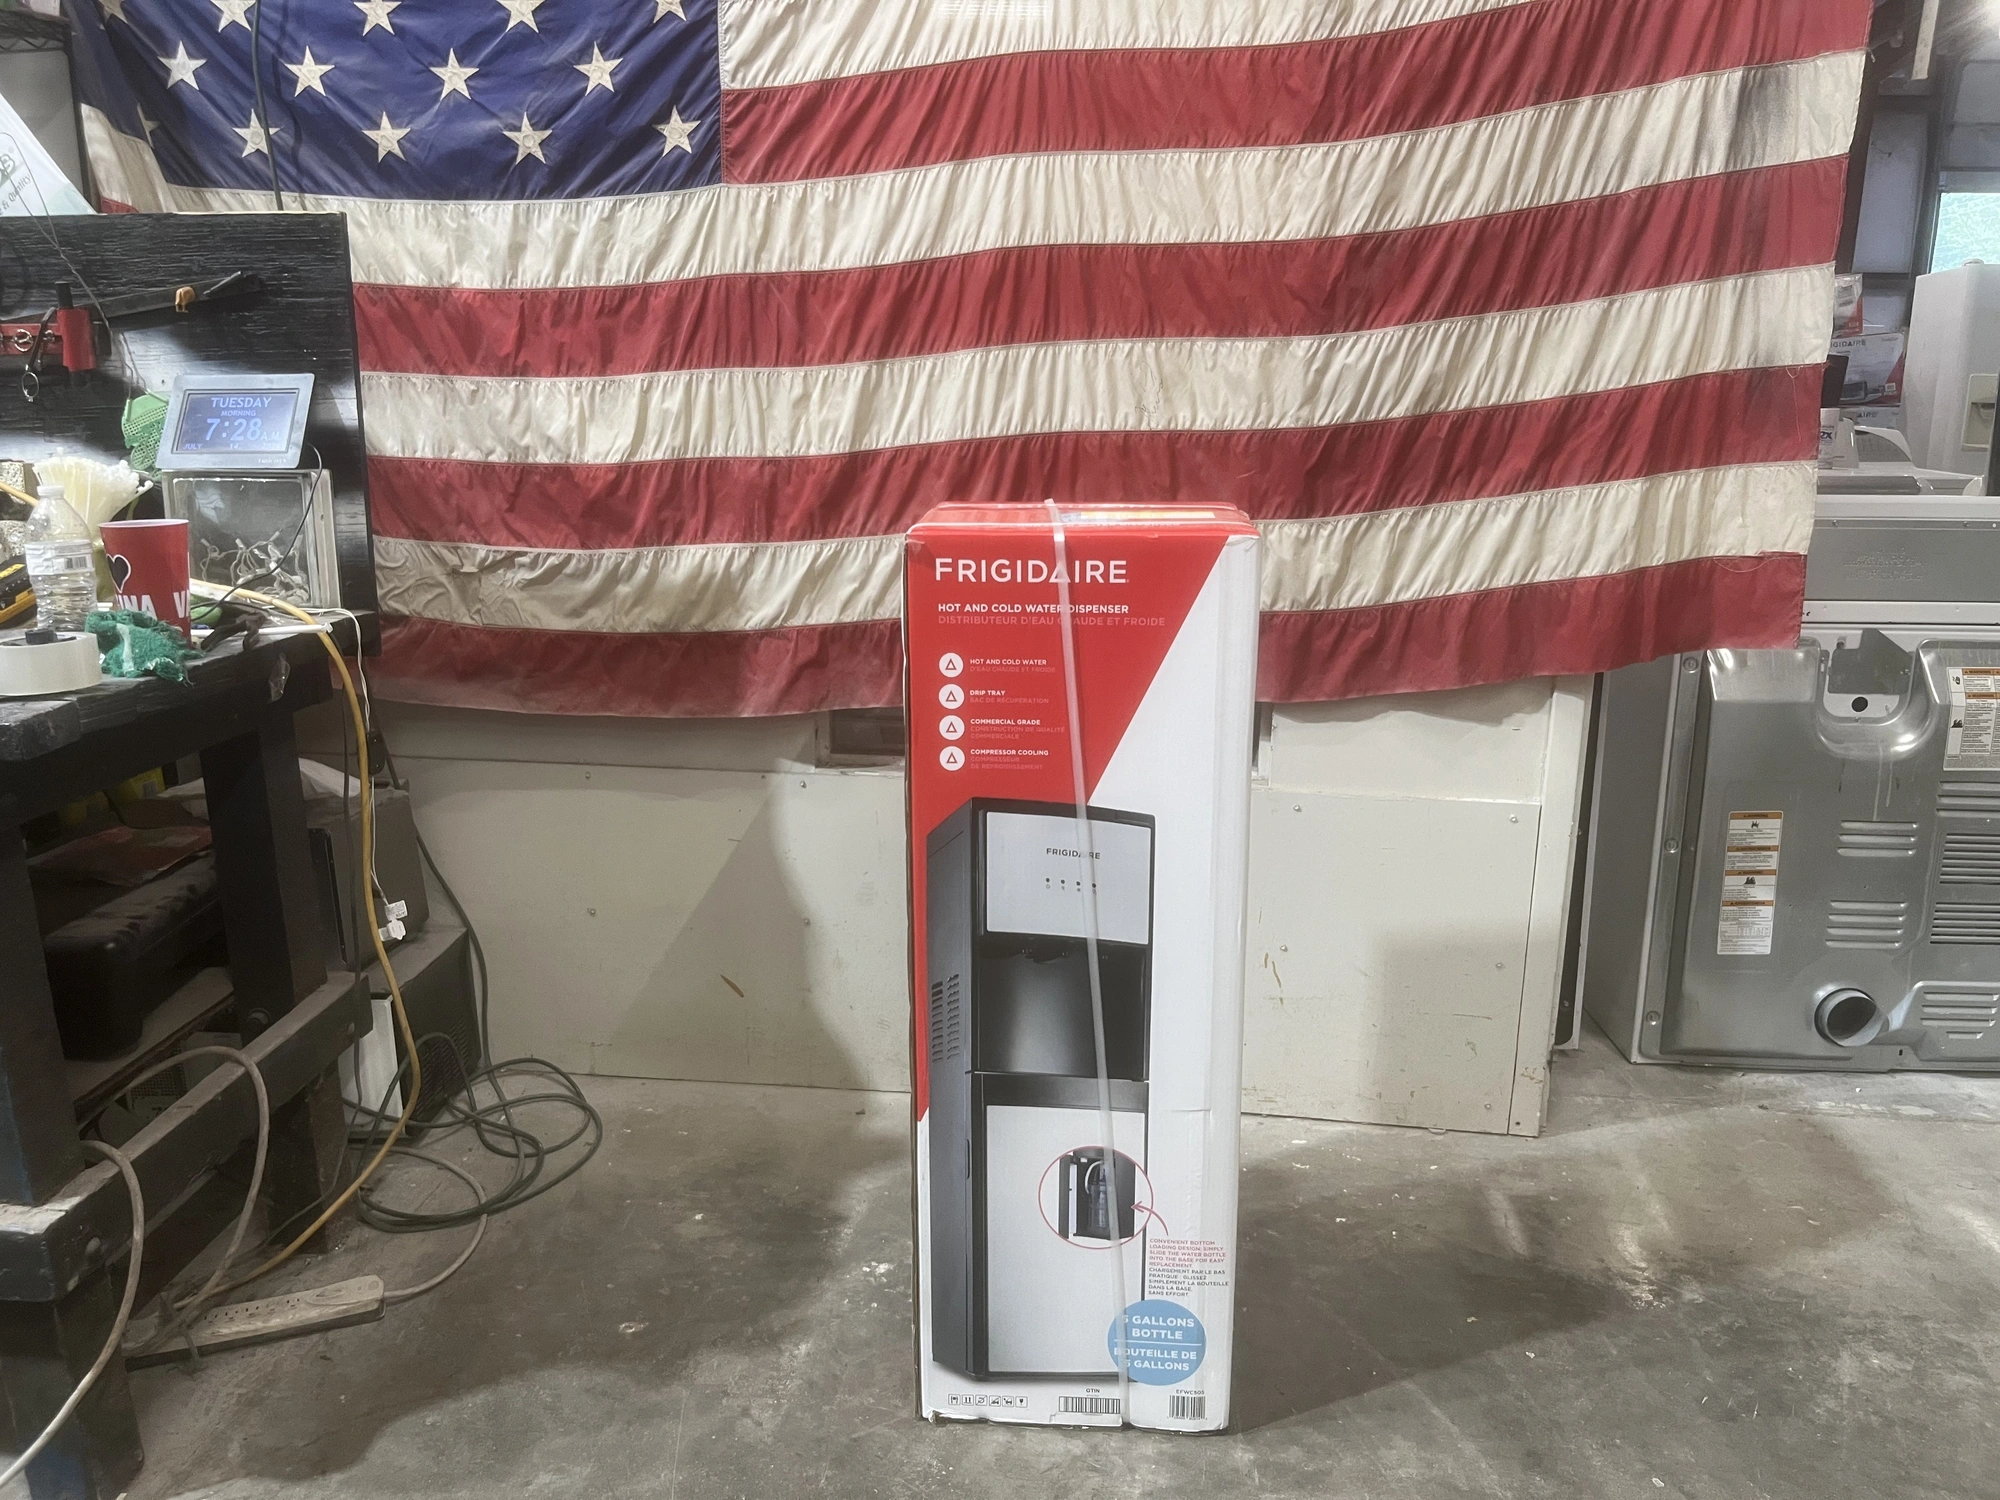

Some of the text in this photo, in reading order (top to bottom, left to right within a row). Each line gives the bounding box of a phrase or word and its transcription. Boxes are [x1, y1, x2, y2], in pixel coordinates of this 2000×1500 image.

[211, 397, 272, 408] TUESDAY
[205, 418, 263, 441] 7:28
[936, 558, 1127, 583] FRIGIDAIRE
[938, 604, 961, 612] HOT
[964, 604, 988, 612] AND
[992, 604, 1022, 613] COLD
[1069, 604, 1129, 614] DISPENSER
[938, 616, 1165, 626] DISTRIBUTEUR D'EAU CAUDE ET FROIDE
[1046, 848, 1101, 859] FRIGIDRE
[1132, 1315, 1195, 1327] GALLONS
[1132, 1328, 1183, 1339] BOTTLE
[1181, 1351, 1197, 1359] DE
[1134, 1360, 1189, 1371] GALLONS
